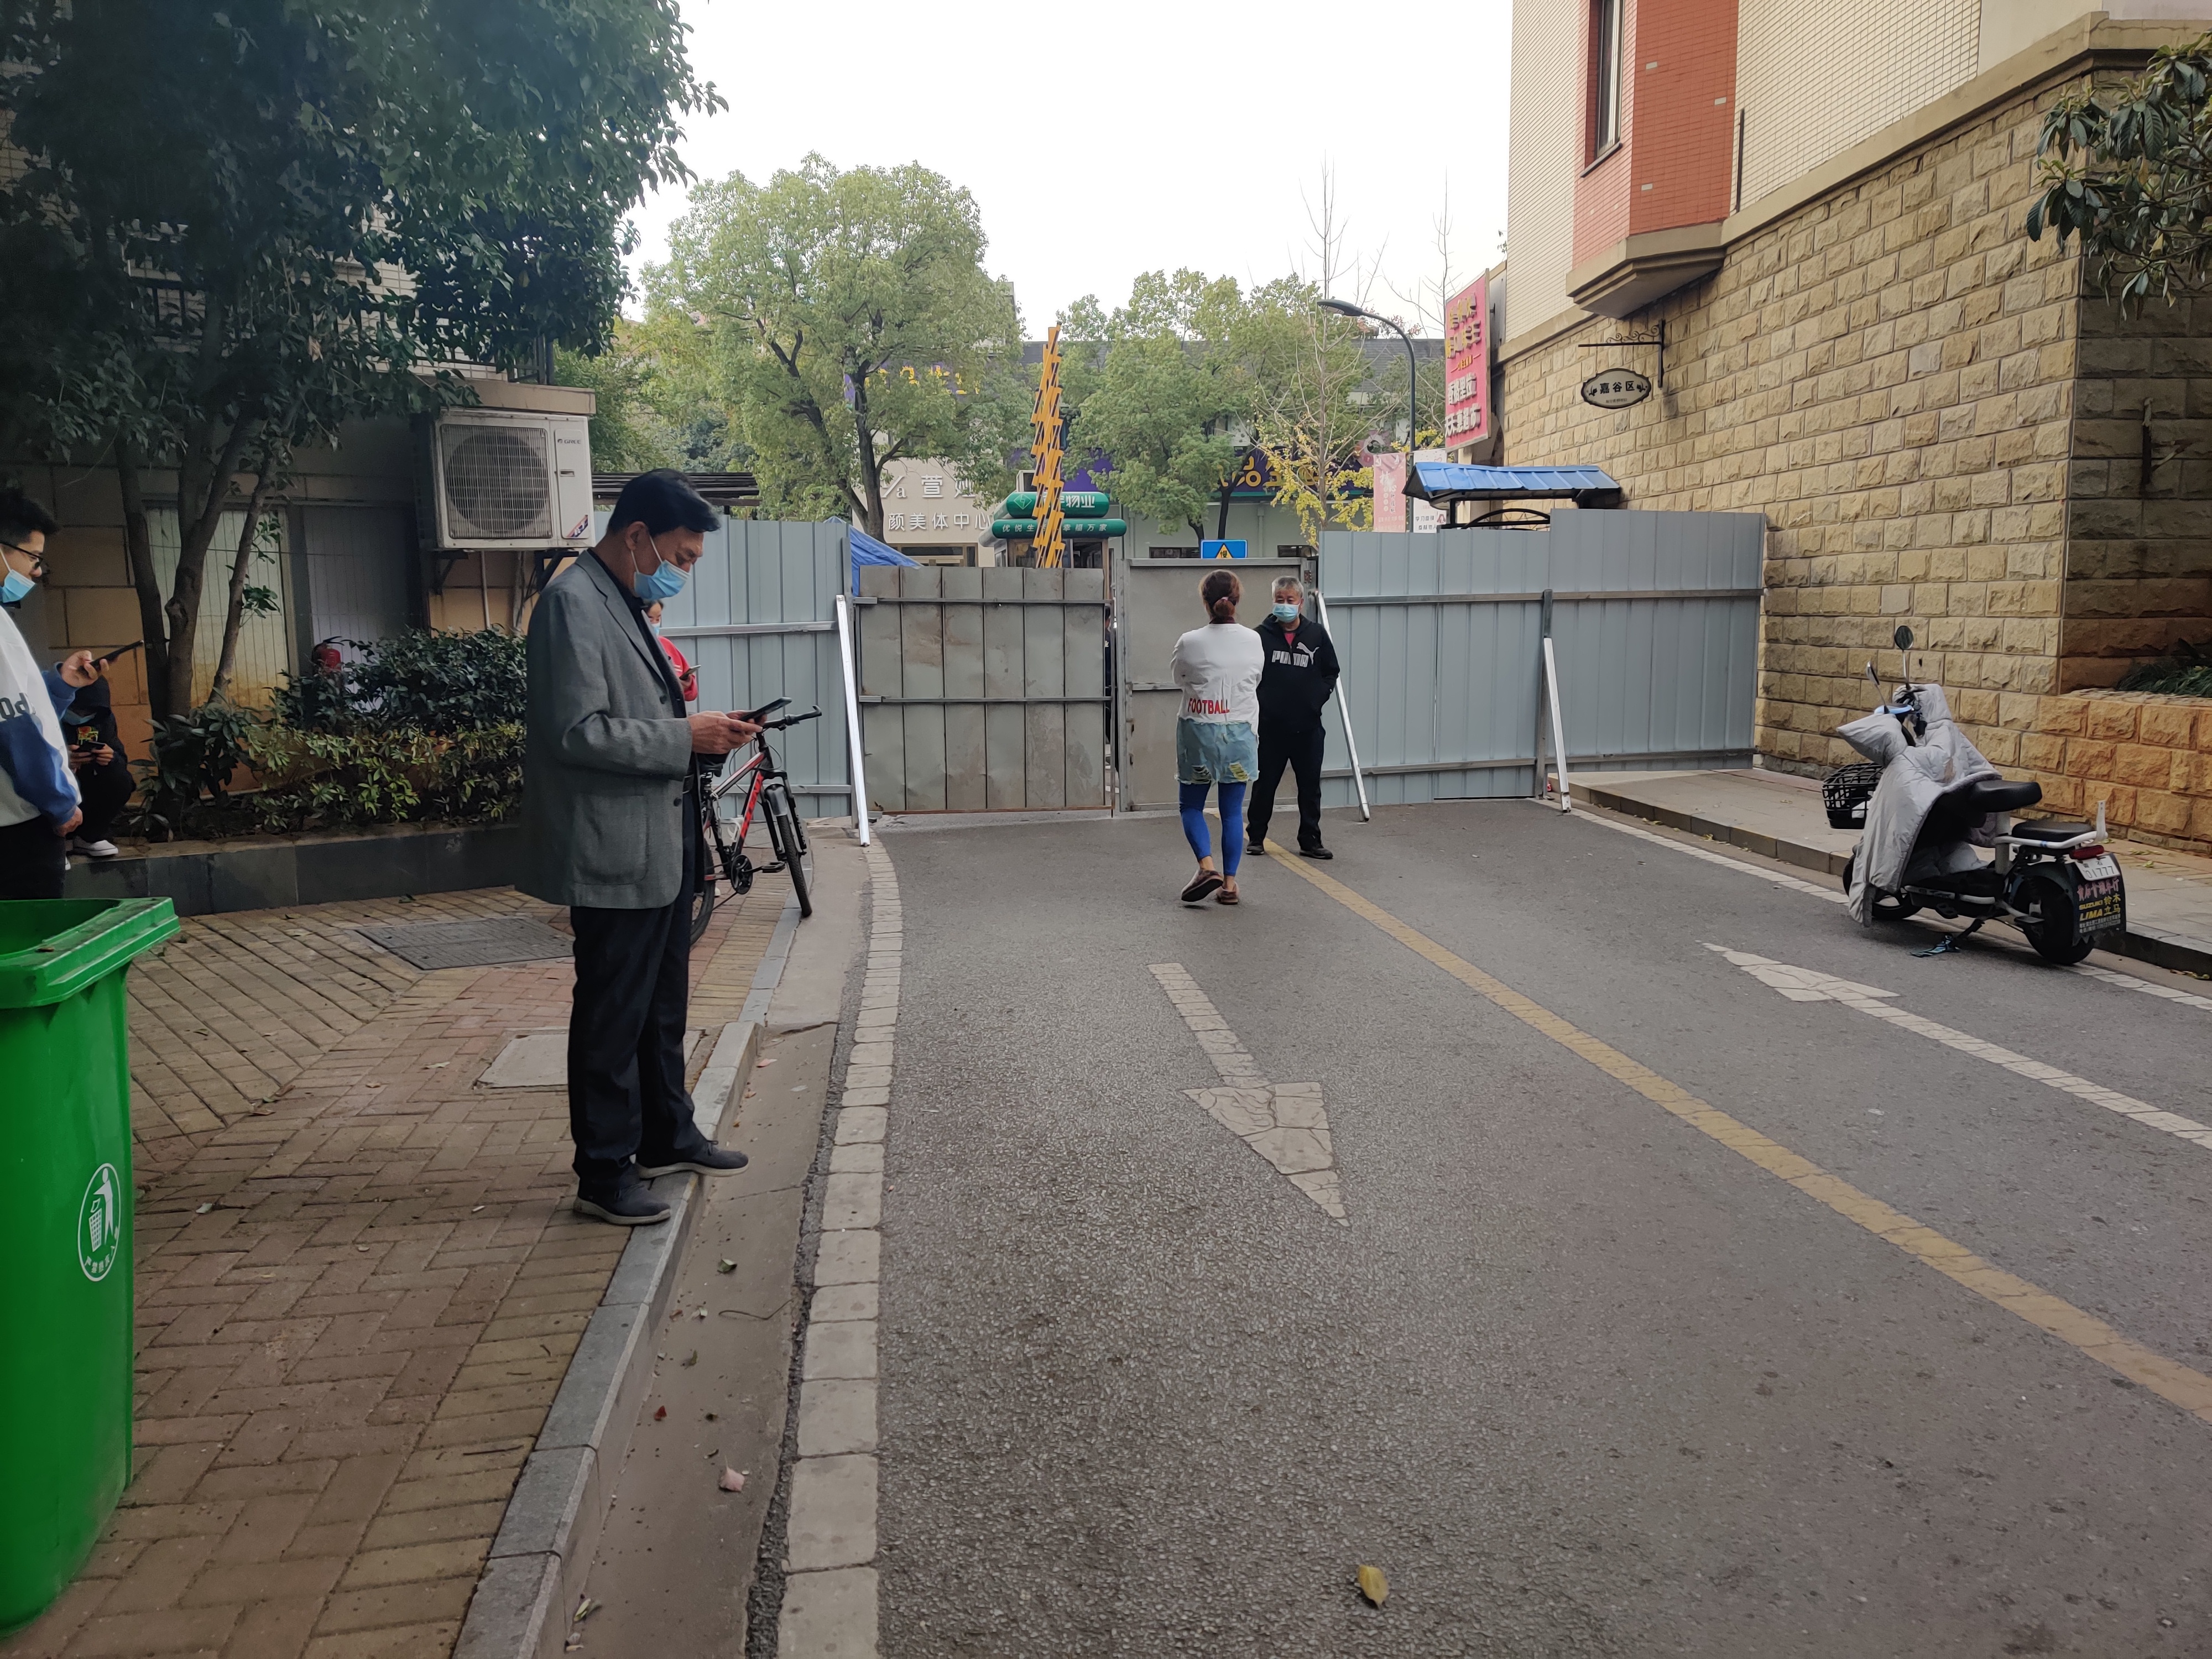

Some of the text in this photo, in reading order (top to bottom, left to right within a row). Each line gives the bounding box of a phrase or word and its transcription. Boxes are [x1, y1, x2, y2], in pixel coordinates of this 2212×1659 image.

[1448, 372, 1477, 406] 香格里拉
[1600, 380, 1635, 394] 嘉谷区
[1444, 402, 1481, 438] 天天惠超市
[888, 511, 990, 531] 颜美体中心
[1062, 523, 1108, 532] 幸福万家
[1272, 650, 1310, 668] PUMA
[1187, 698, 1230, 714] FOOTBALL
[2079, 893, 2121, 910] SUZUKI 铃木
[2079, 908, 2103, 922] LIMA
[2104, 904, 2121, 916] 立马
